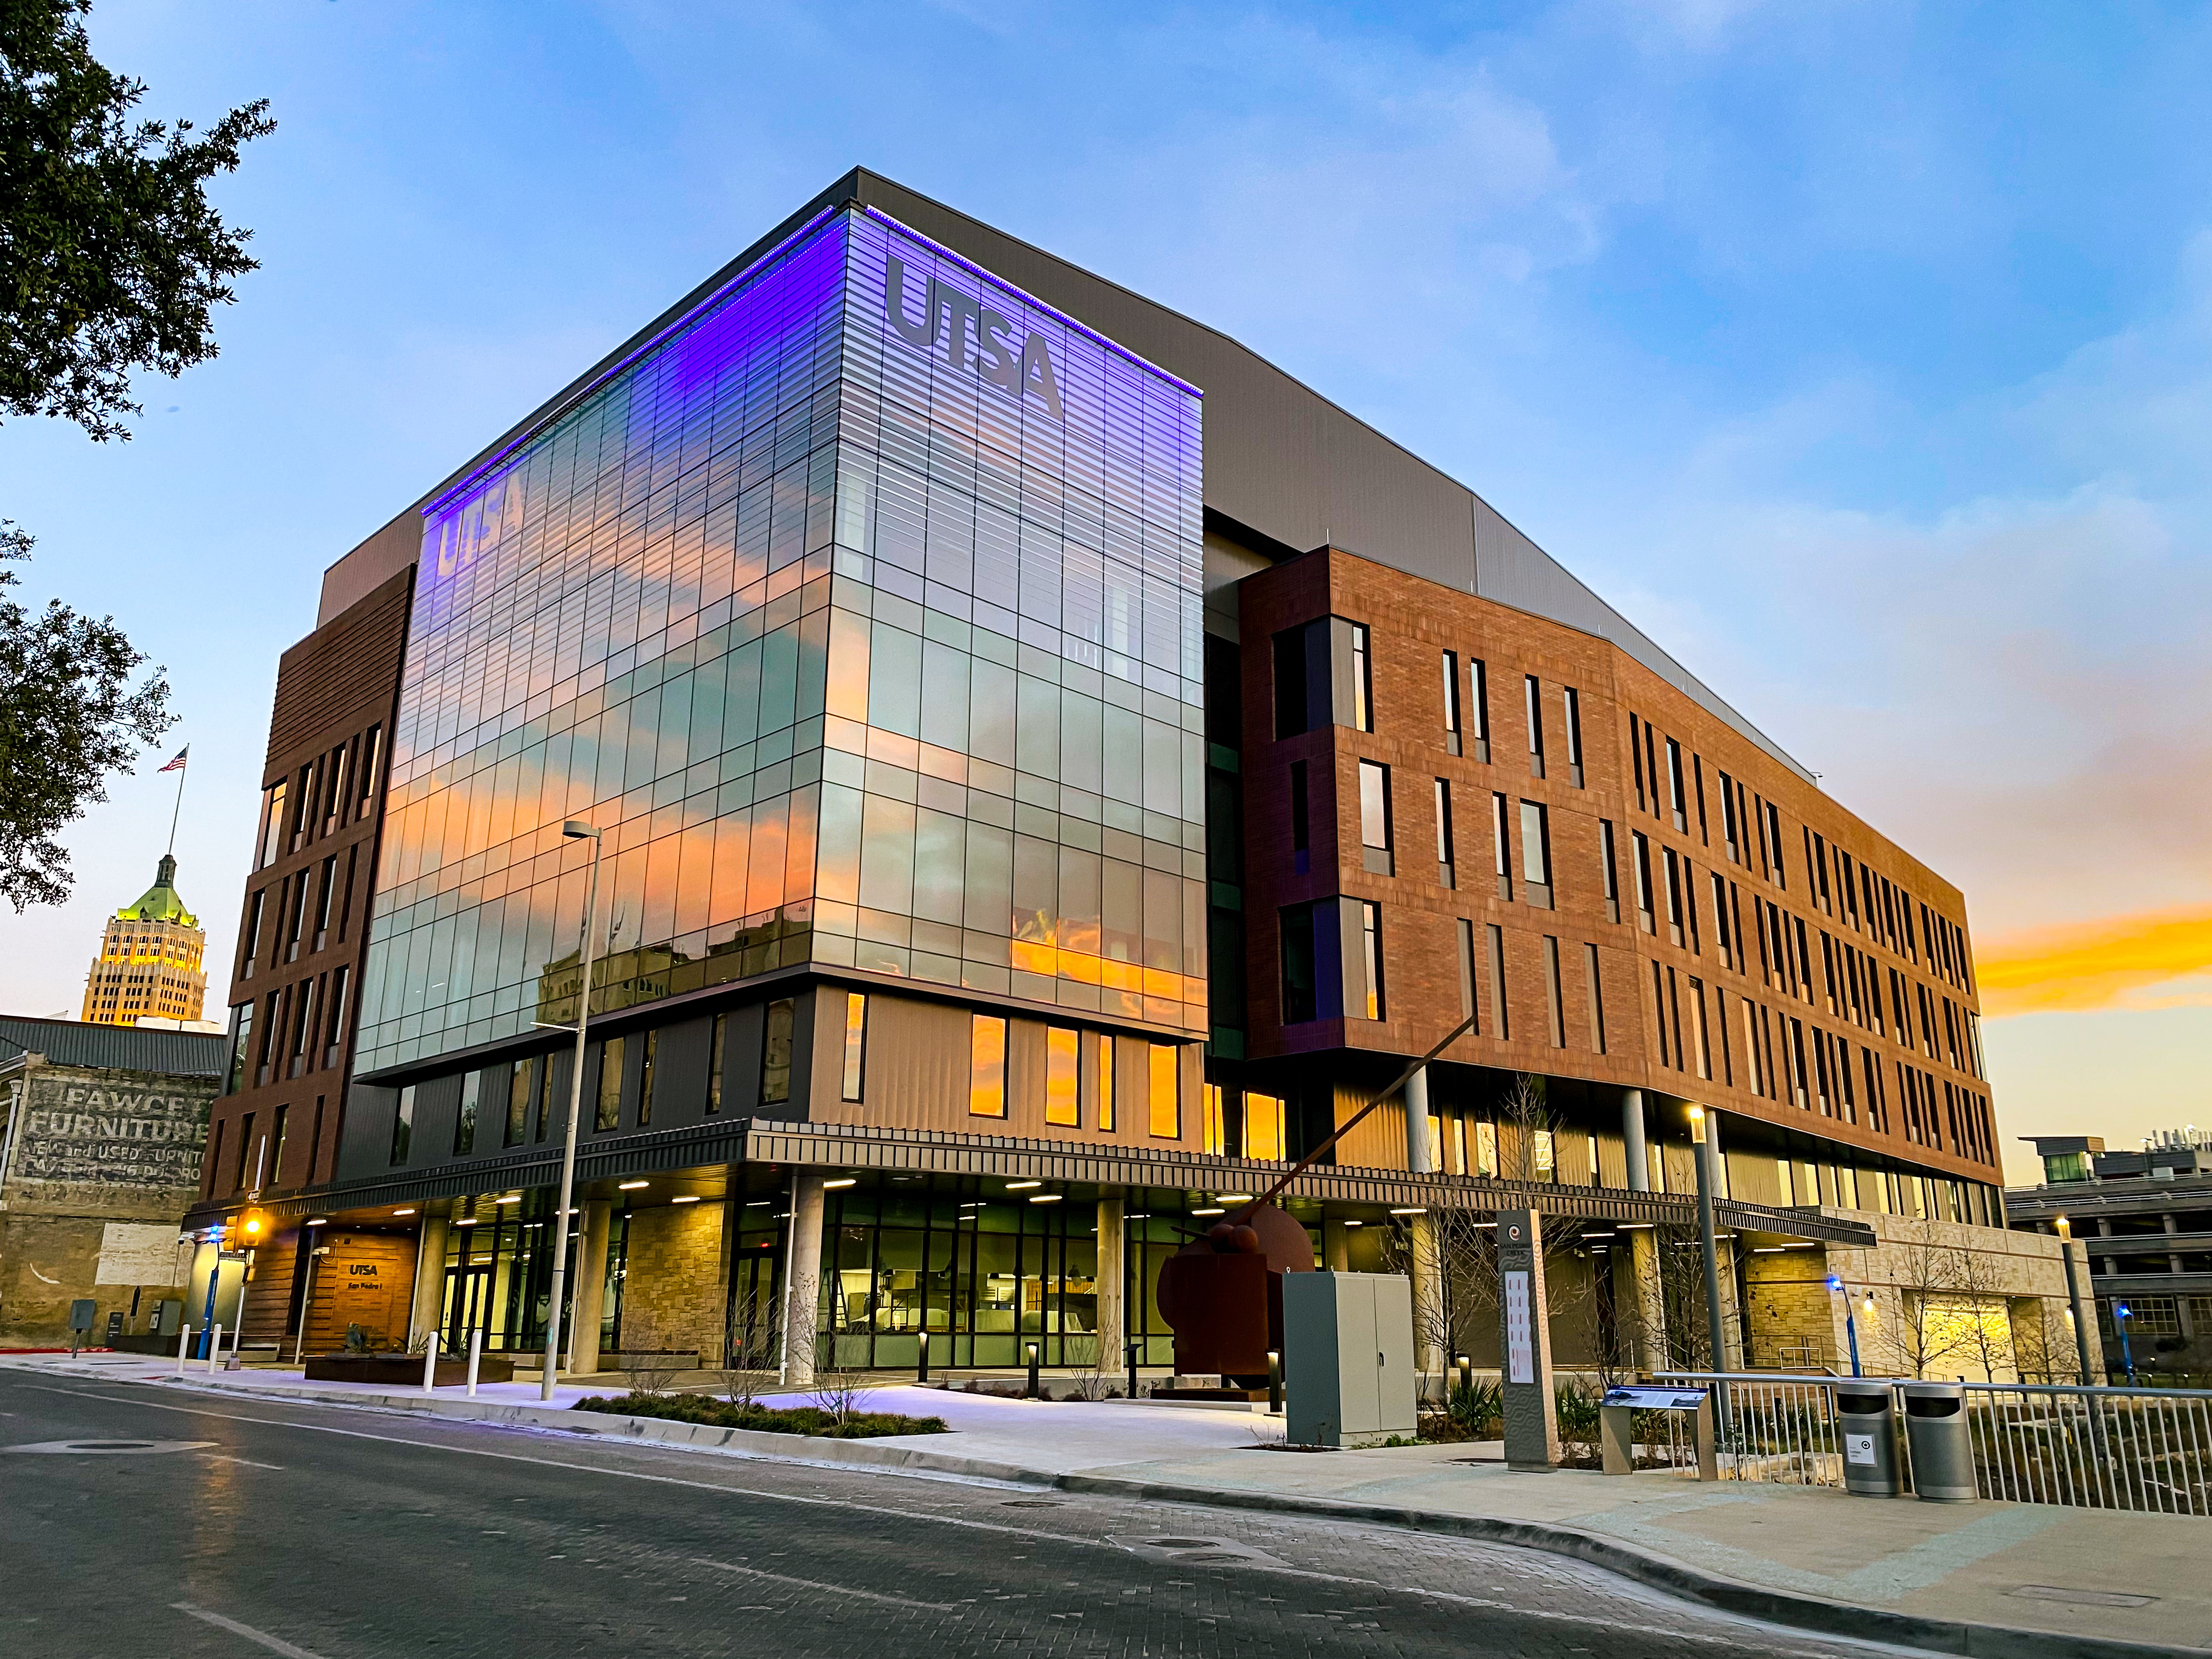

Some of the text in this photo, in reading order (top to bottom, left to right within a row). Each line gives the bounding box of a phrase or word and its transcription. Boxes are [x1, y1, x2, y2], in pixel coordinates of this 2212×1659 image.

[885, 255, 1065, 421] UTSA
[438, 472, 524, 576] UTSA
[350, 1265, 377, 1276] UTSA
